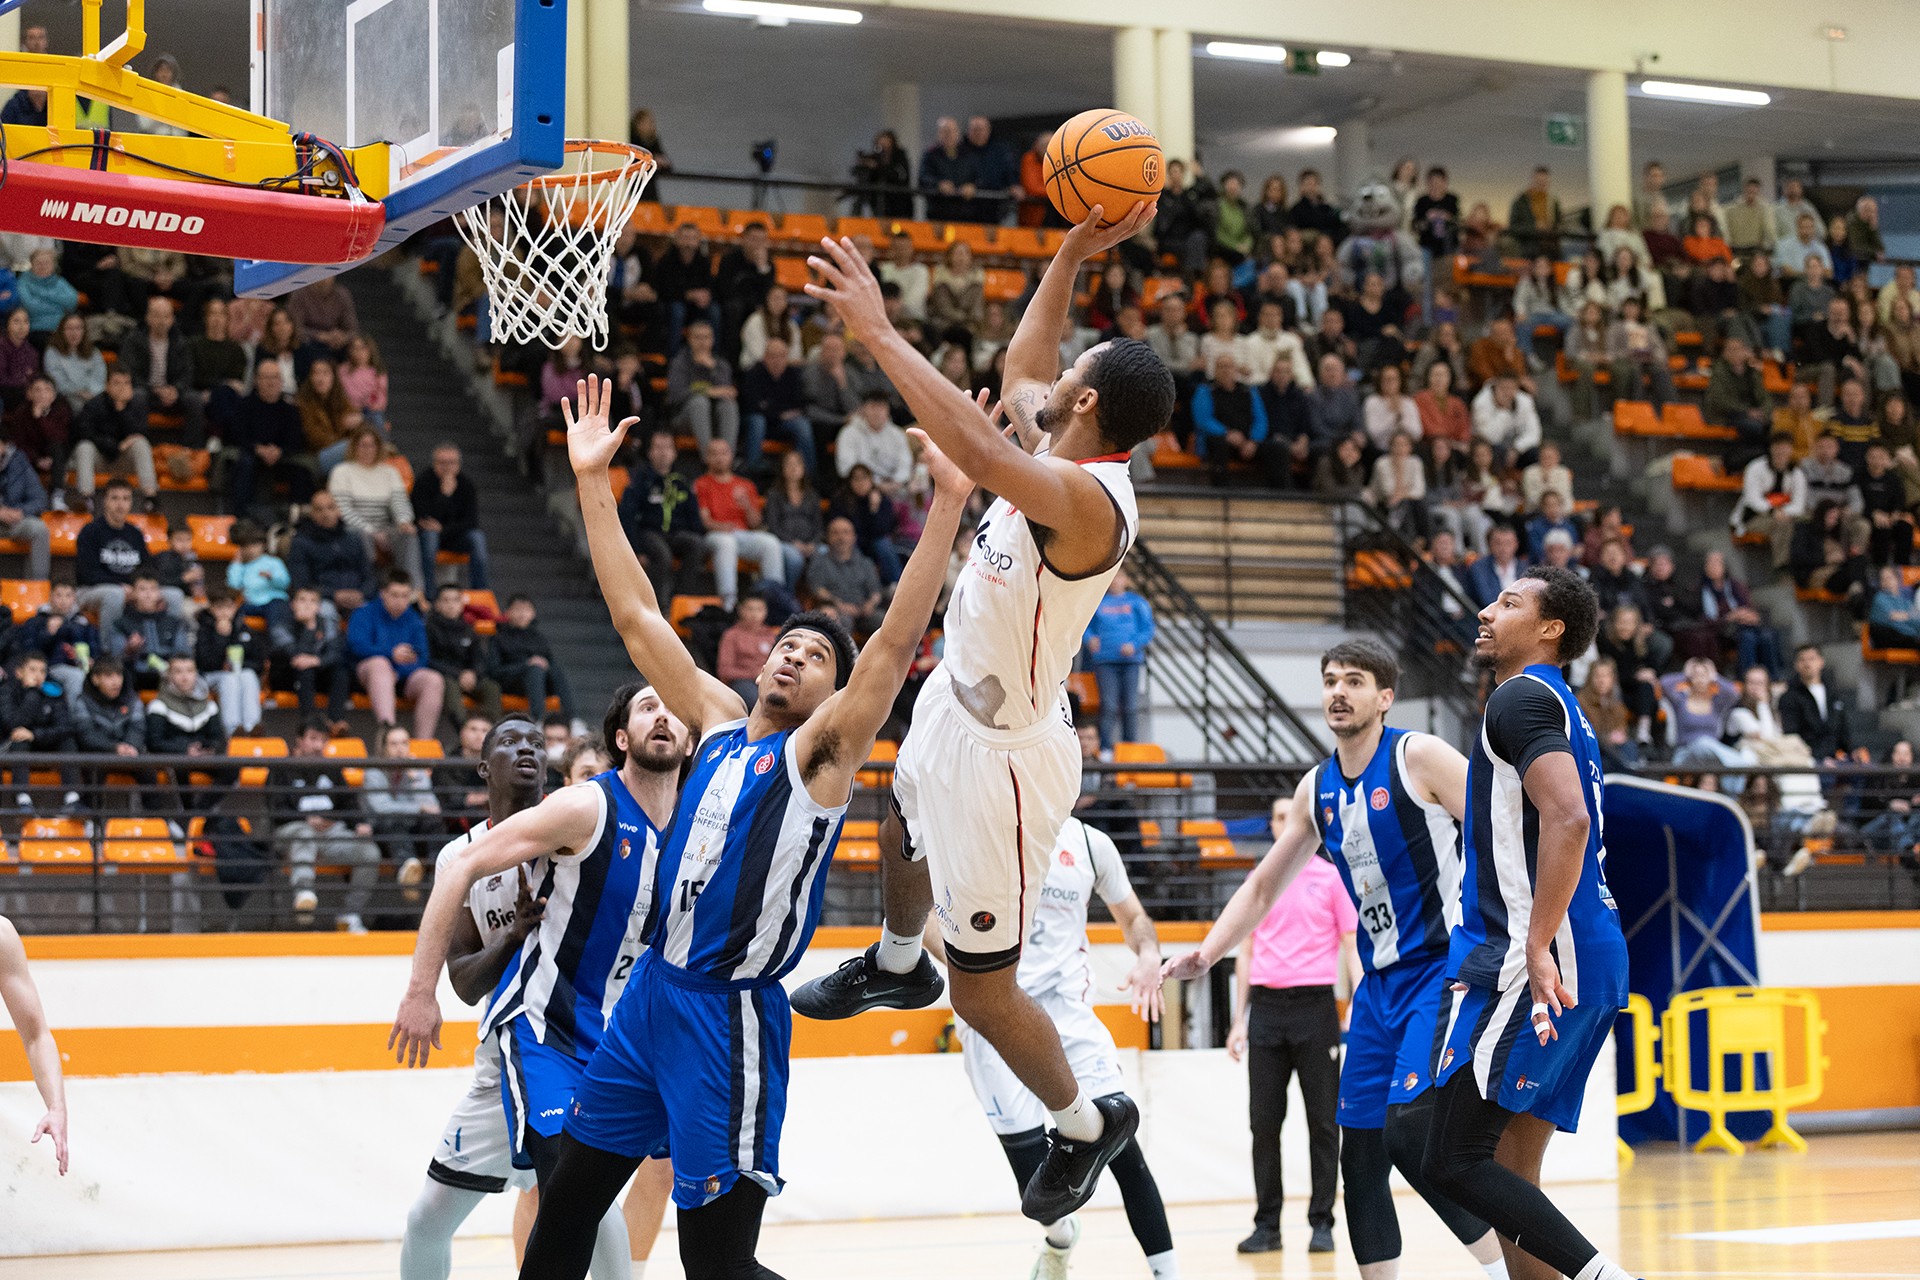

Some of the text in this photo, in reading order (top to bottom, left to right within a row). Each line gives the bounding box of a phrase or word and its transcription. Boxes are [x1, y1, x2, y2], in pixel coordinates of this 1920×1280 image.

[70, 201, 205, 236] MONDO
[679, 879, 706, 914] 15
[1364, 902, 1393, 935] 33
[613, 955, 635, 980] 2
